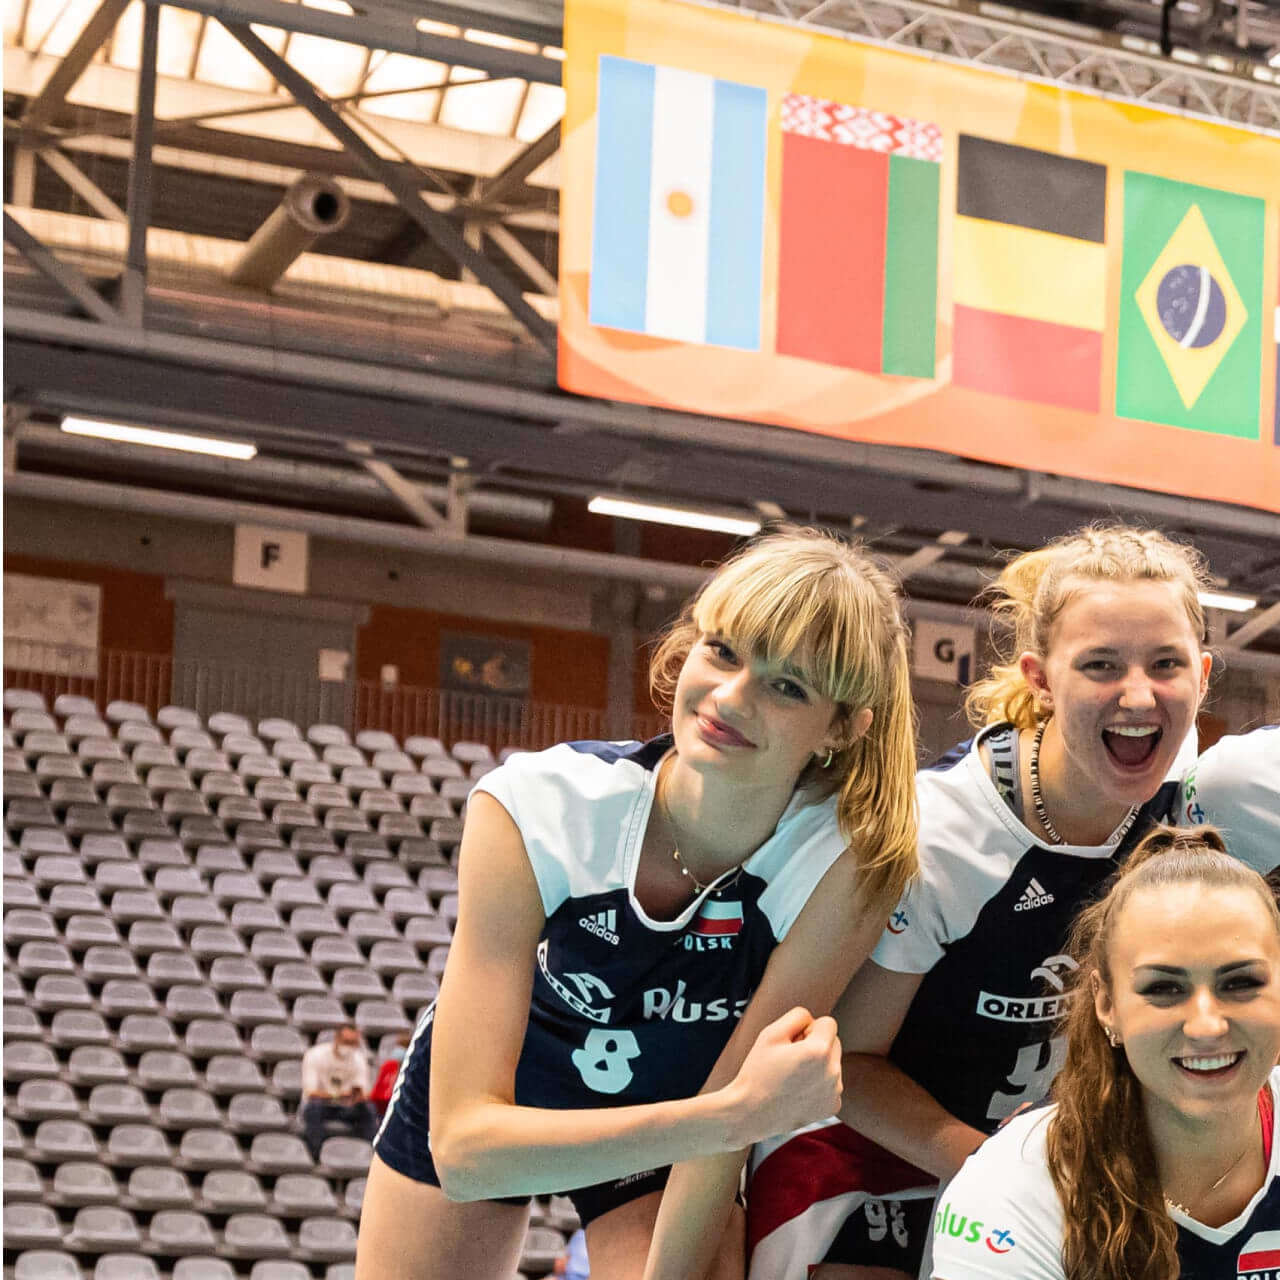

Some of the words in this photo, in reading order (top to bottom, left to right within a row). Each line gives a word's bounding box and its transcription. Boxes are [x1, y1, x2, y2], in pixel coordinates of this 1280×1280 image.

[258, 543, 279, 572] F
[933, 637, 955, 663] G
[1014, 893, 1055, 912] adidas
[578, 916, 621, 946] adidas
[570, 1027, 642, 1094] 8
